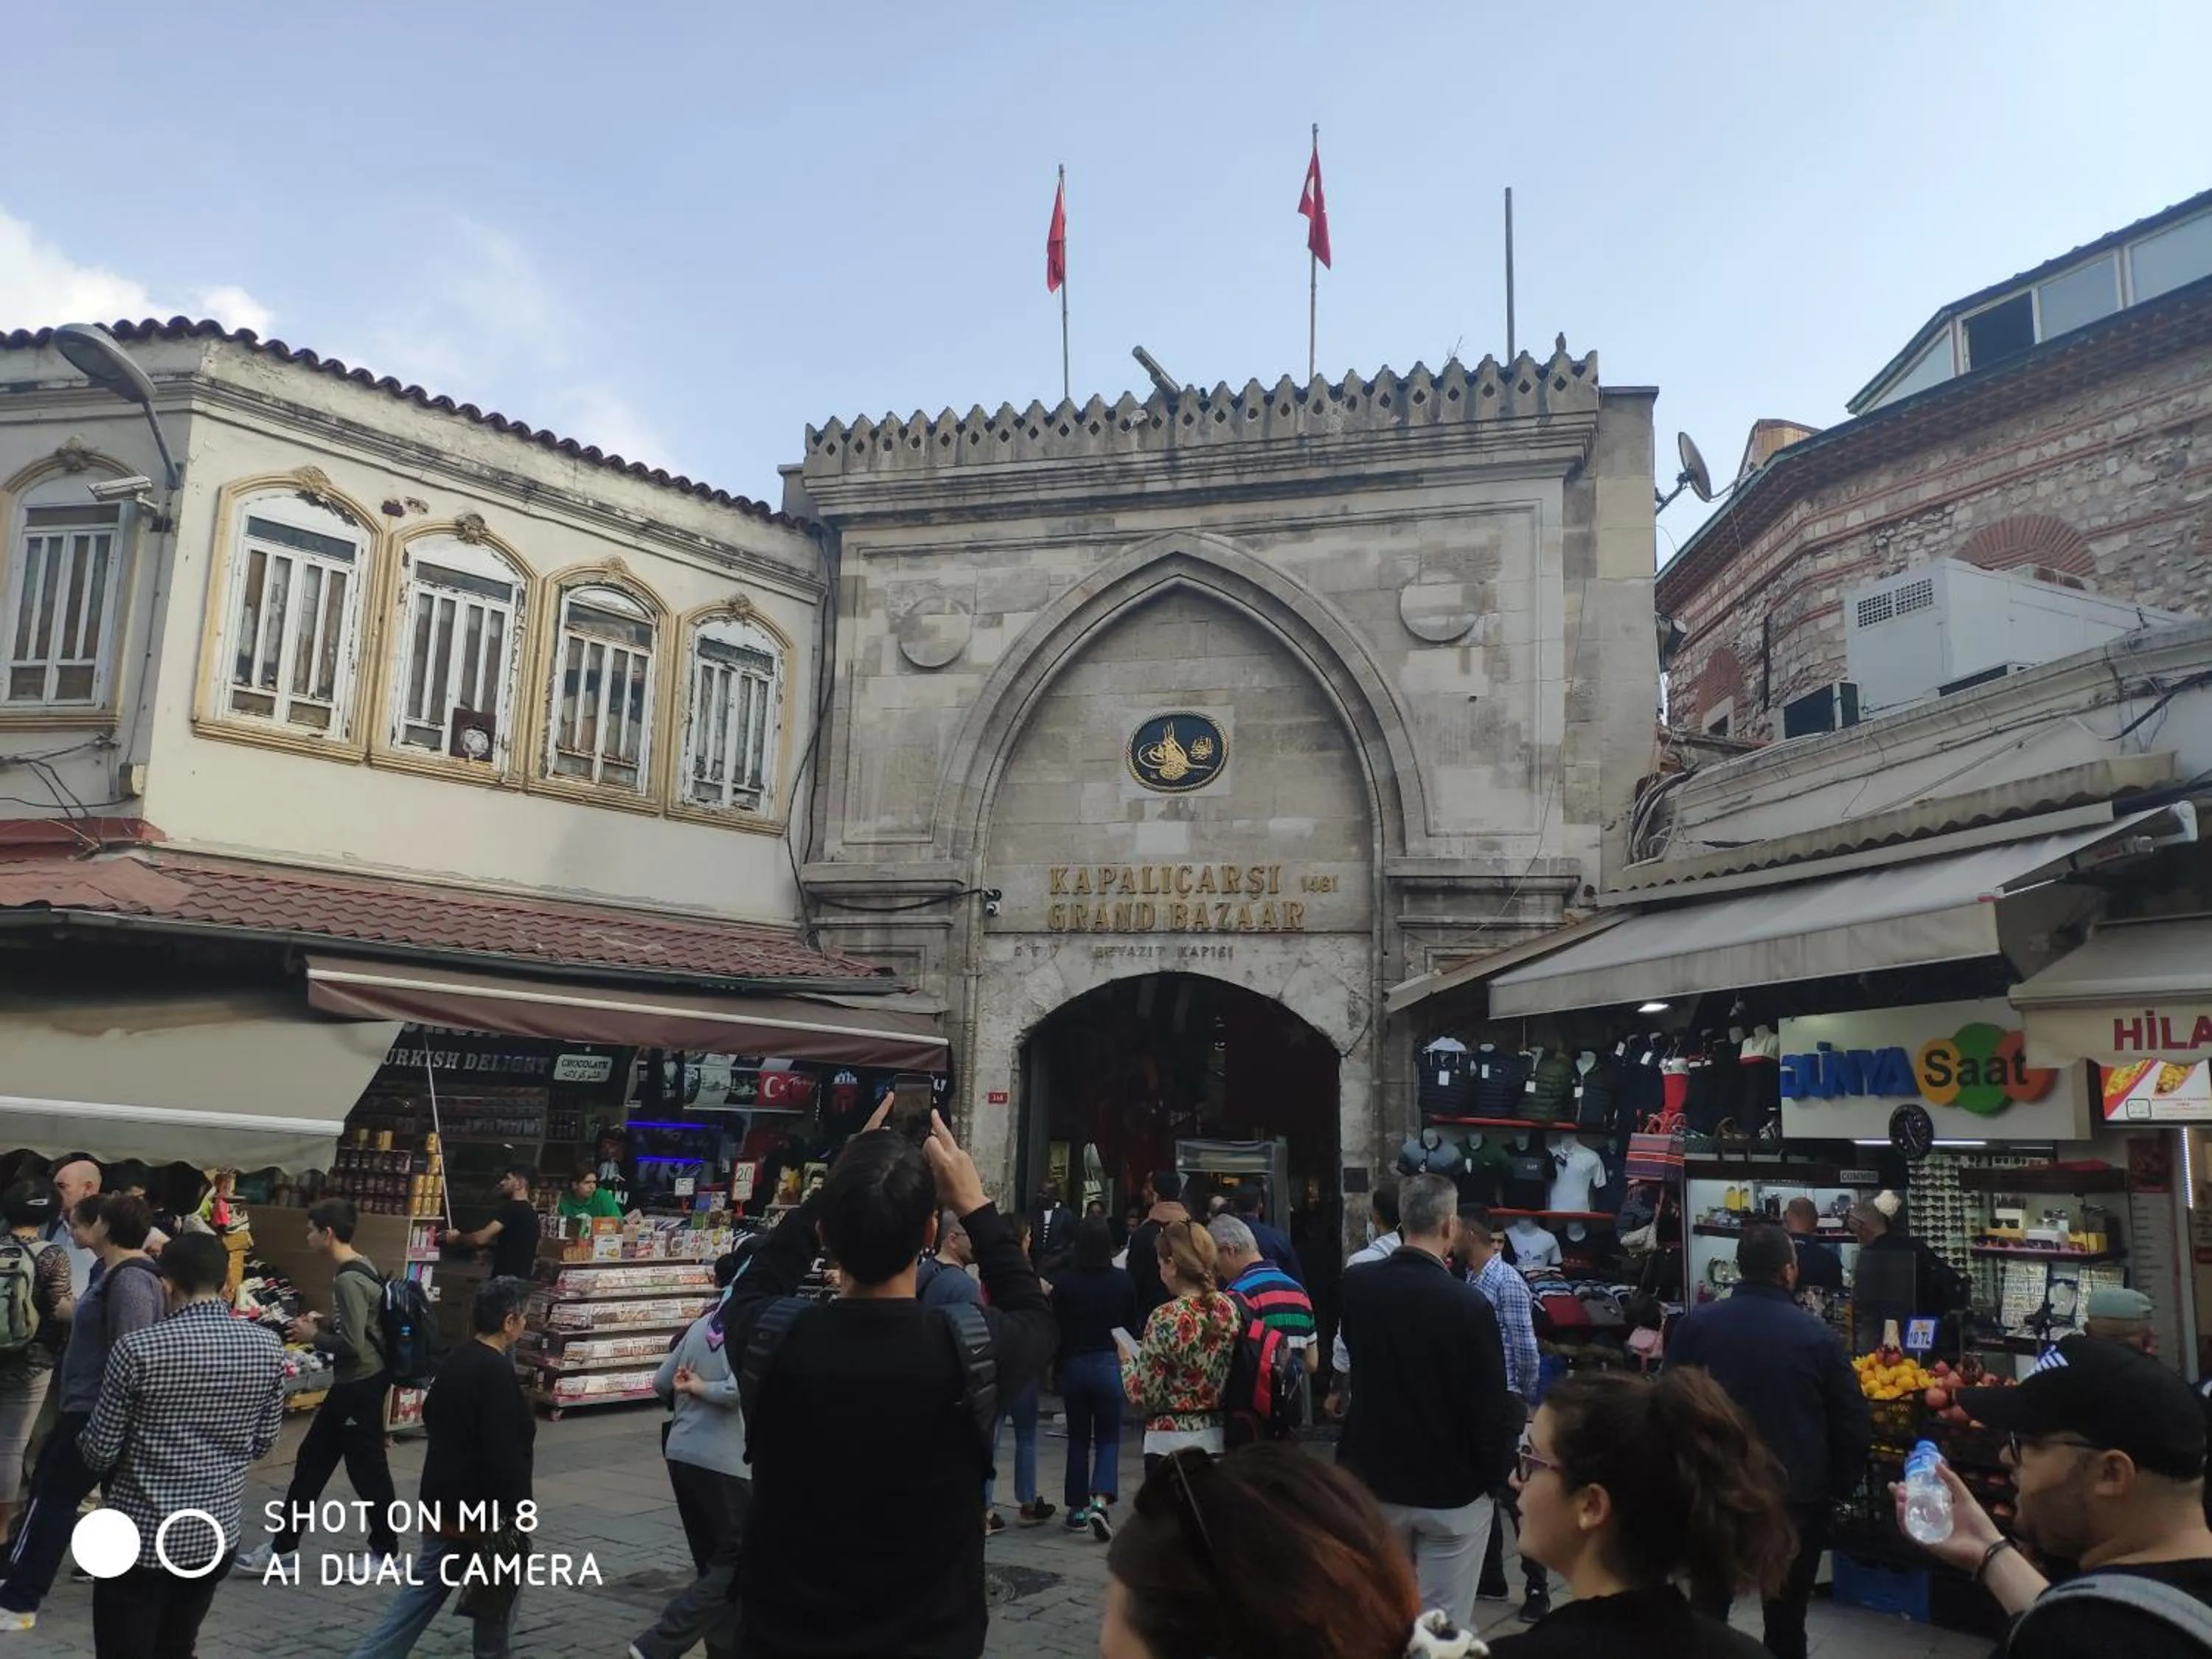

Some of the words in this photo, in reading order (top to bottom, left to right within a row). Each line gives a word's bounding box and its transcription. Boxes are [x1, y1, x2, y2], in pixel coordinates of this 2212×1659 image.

[1049, 864, 1281, 900] KAPALIÇARŞI
[1048, 901, 1155, 931] GRAND
[1169, 901, 1304, 931] BAZAAR
[382, 1047, 461, 1069] URKISH
[1924, 1042, 2029, 1088] Saat
